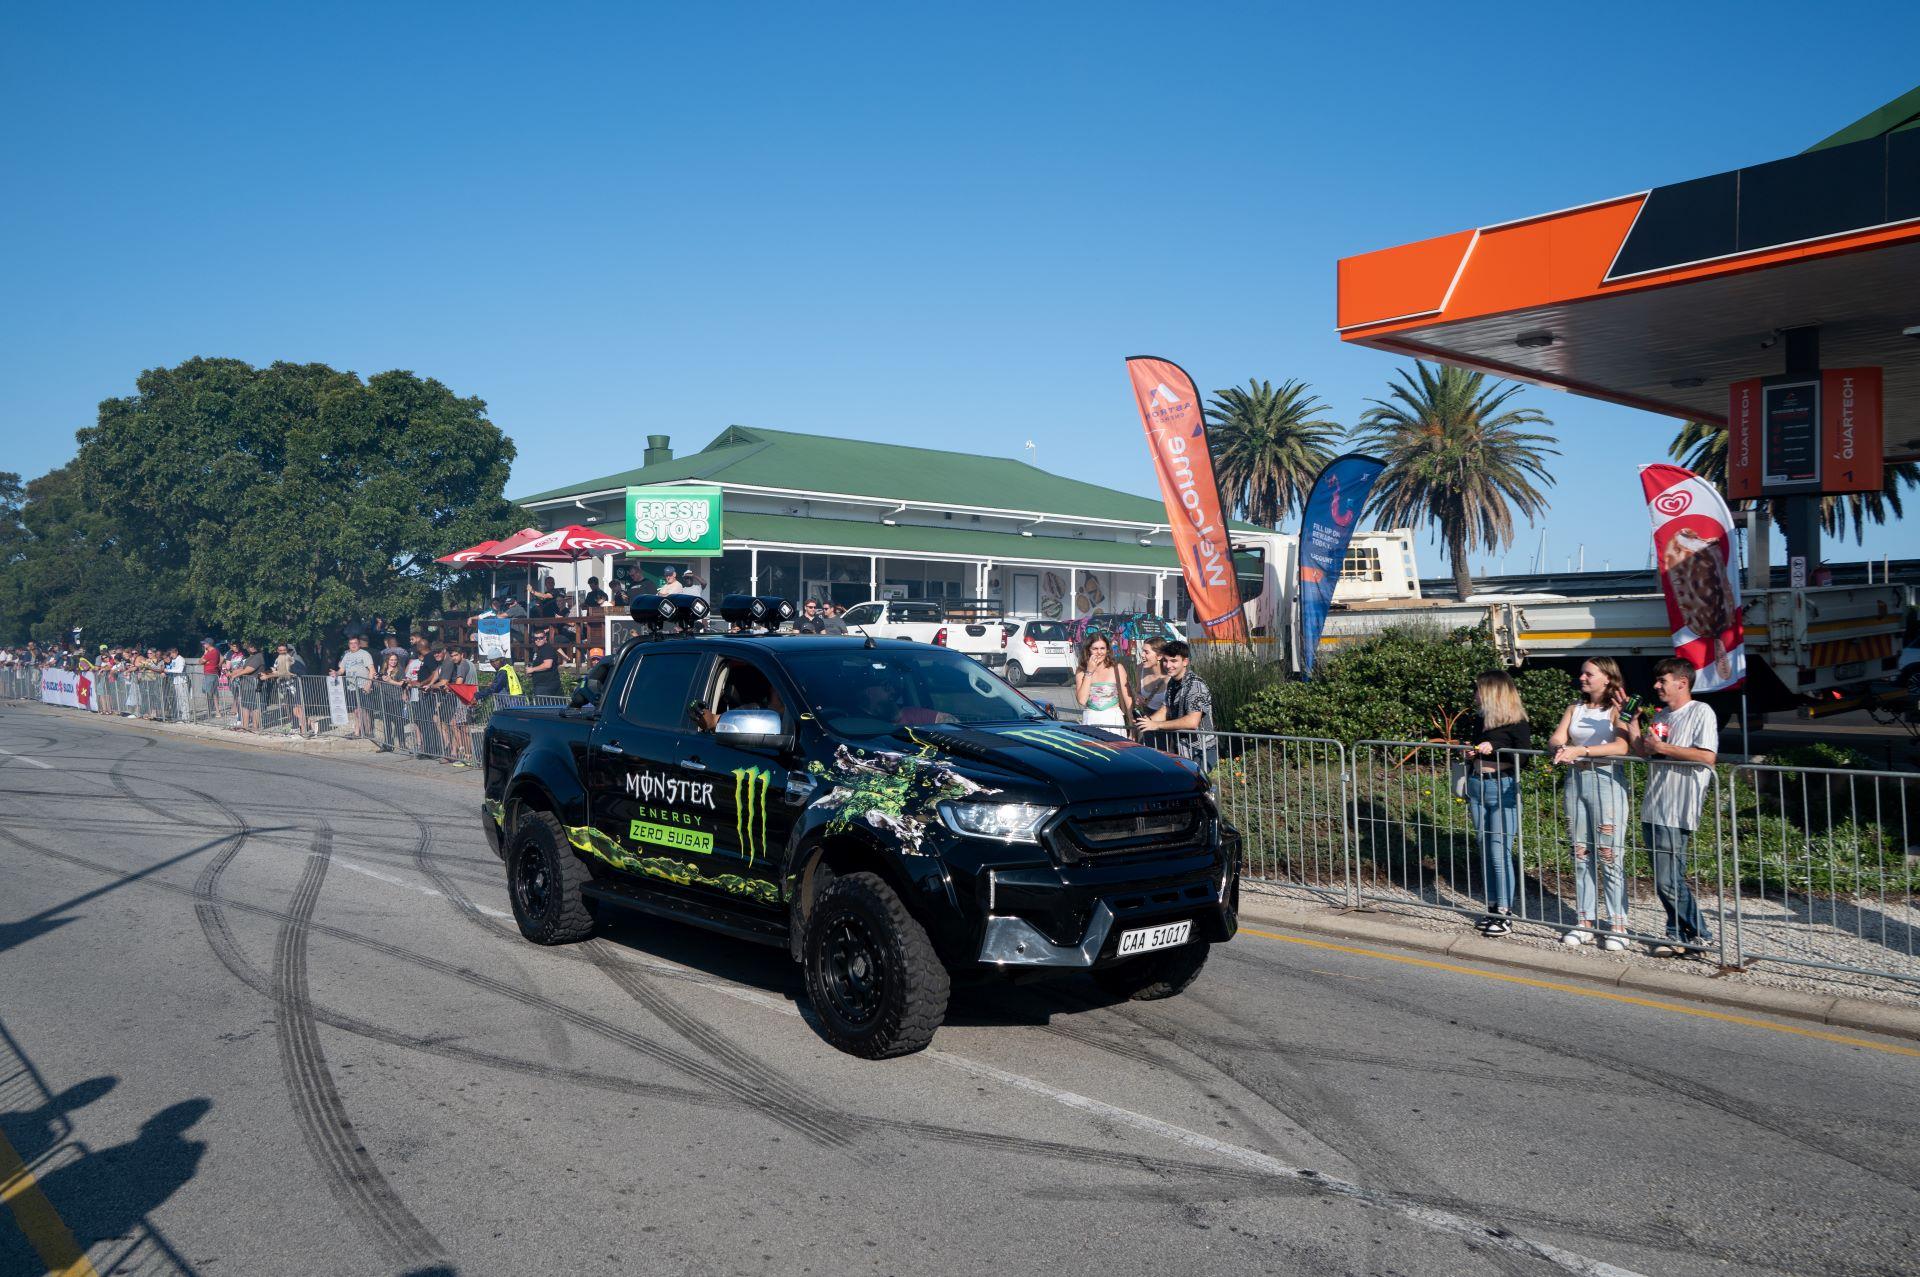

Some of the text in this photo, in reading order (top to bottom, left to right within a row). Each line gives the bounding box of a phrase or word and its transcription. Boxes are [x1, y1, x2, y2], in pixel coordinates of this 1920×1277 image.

[1741, 388, 1749, 467] QUARTECH
[1842, 378, 1854, 460] QUARTECH
[636, 500, 709, 520] FRESH
[635, 519, 709, 542] STOP
[1313, 522, 1323, 531] FILL
[1324, 527, 1333, 535] UP
[625, 769, 716, 810] MONSTER
[639, 806, 702, 826] ENERGY
[632, 825, 710, 850] ZERO SUGAR
[1123, 924, 1188, 952] CAA 51017
